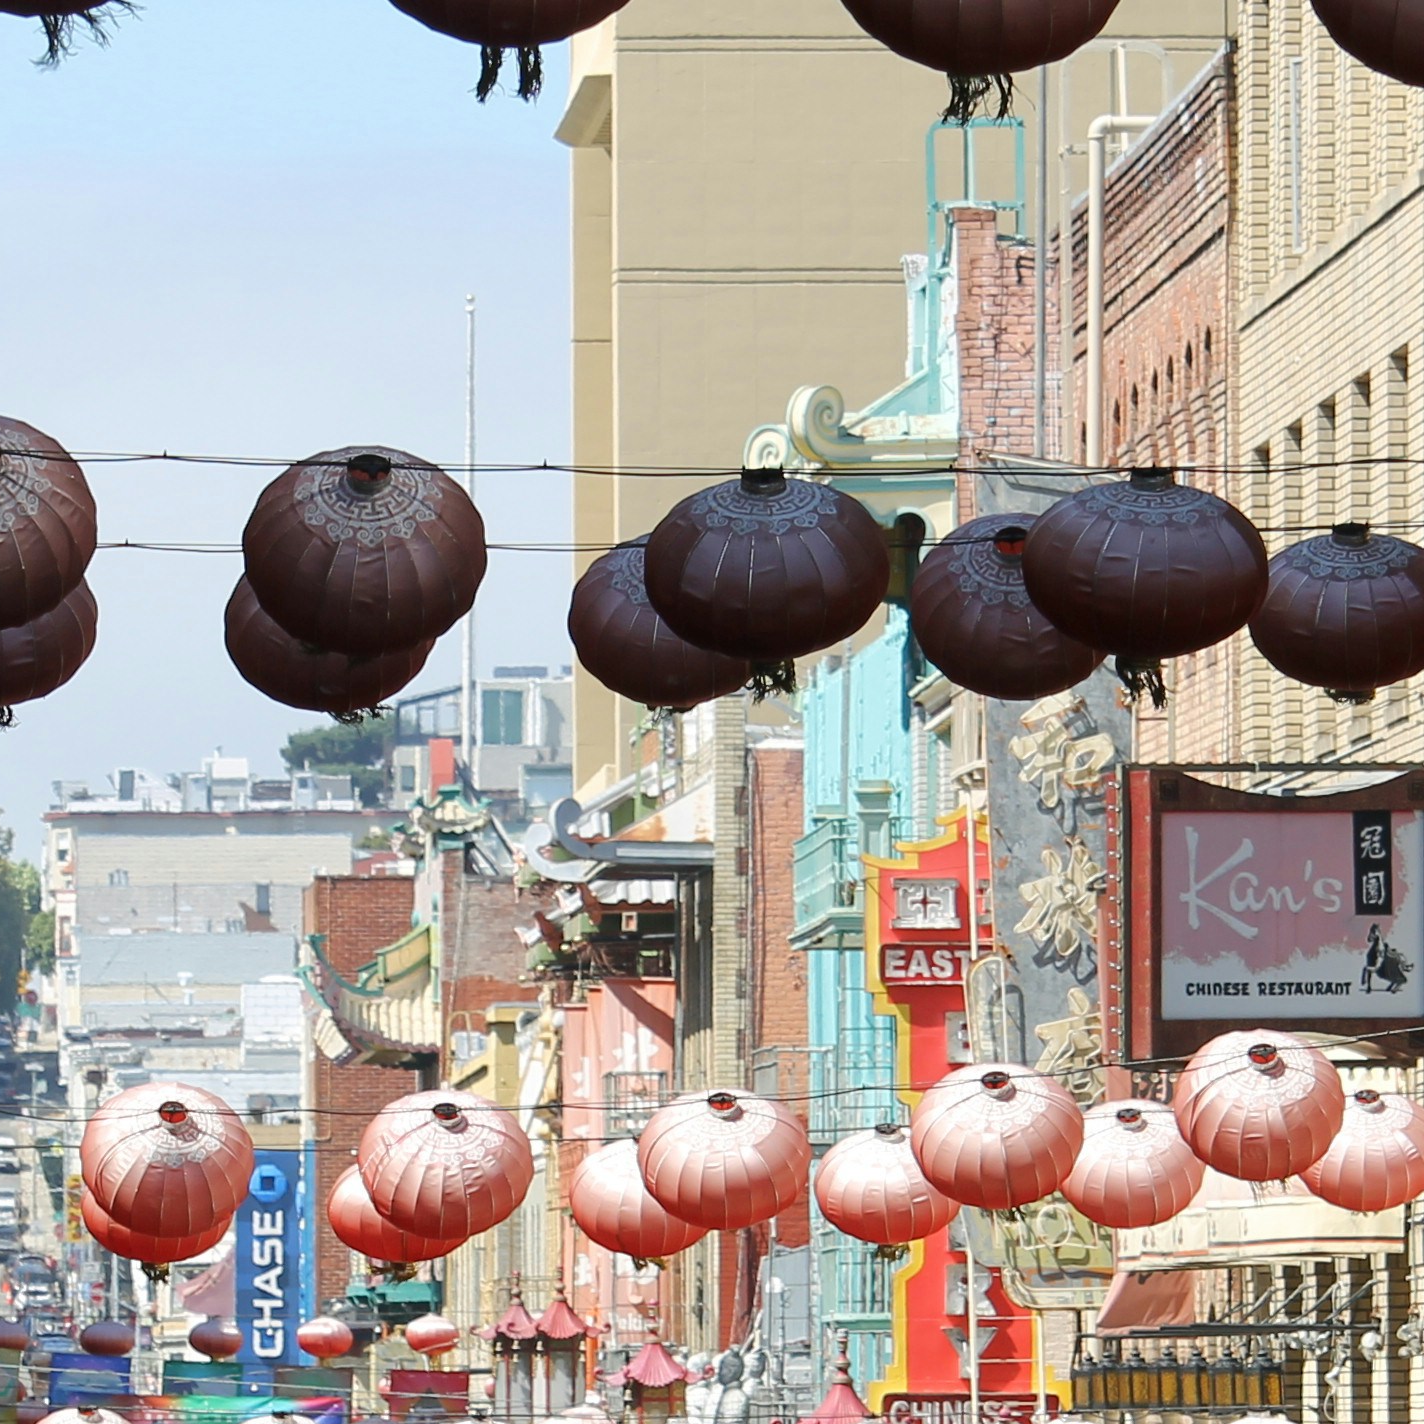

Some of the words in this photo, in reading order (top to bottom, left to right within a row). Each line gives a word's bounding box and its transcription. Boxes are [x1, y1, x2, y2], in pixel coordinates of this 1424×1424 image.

[1179, 826, 1343, 940] Kan's
[1185, 981, 1251, 997] CHINESE
[1258, 981, 1352, 997] RESTAURANT
[252, 1209, 284, 1358] CHASE
